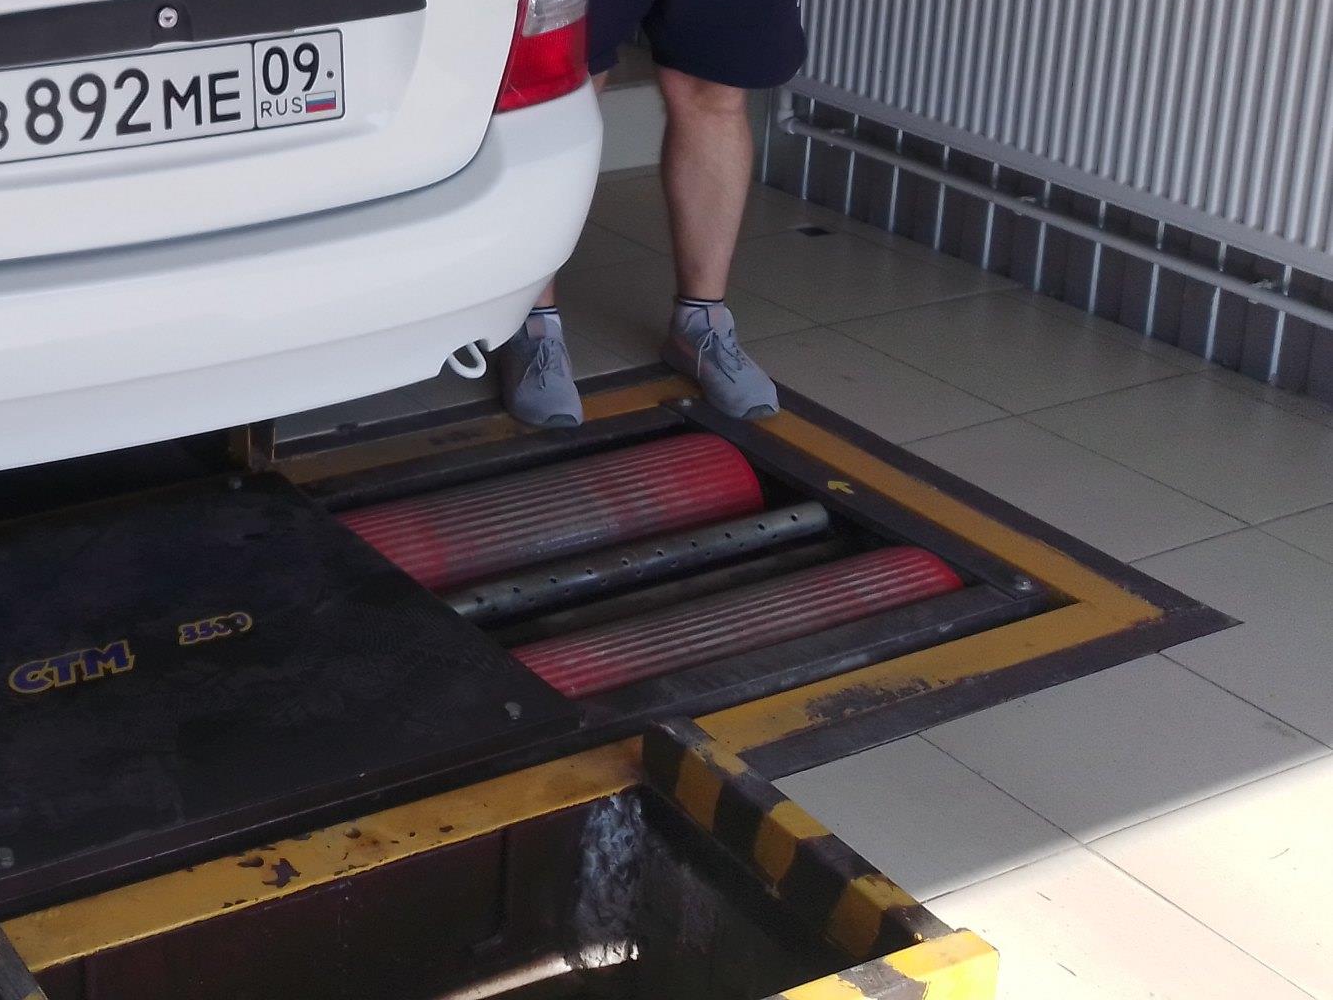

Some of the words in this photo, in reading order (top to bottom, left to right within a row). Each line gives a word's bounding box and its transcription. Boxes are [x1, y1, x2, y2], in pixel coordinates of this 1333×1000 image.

[261, 42, 320, 96] 09
[259, 96, 303, 119] RUS
[8, 639, 135, 694] CTM
